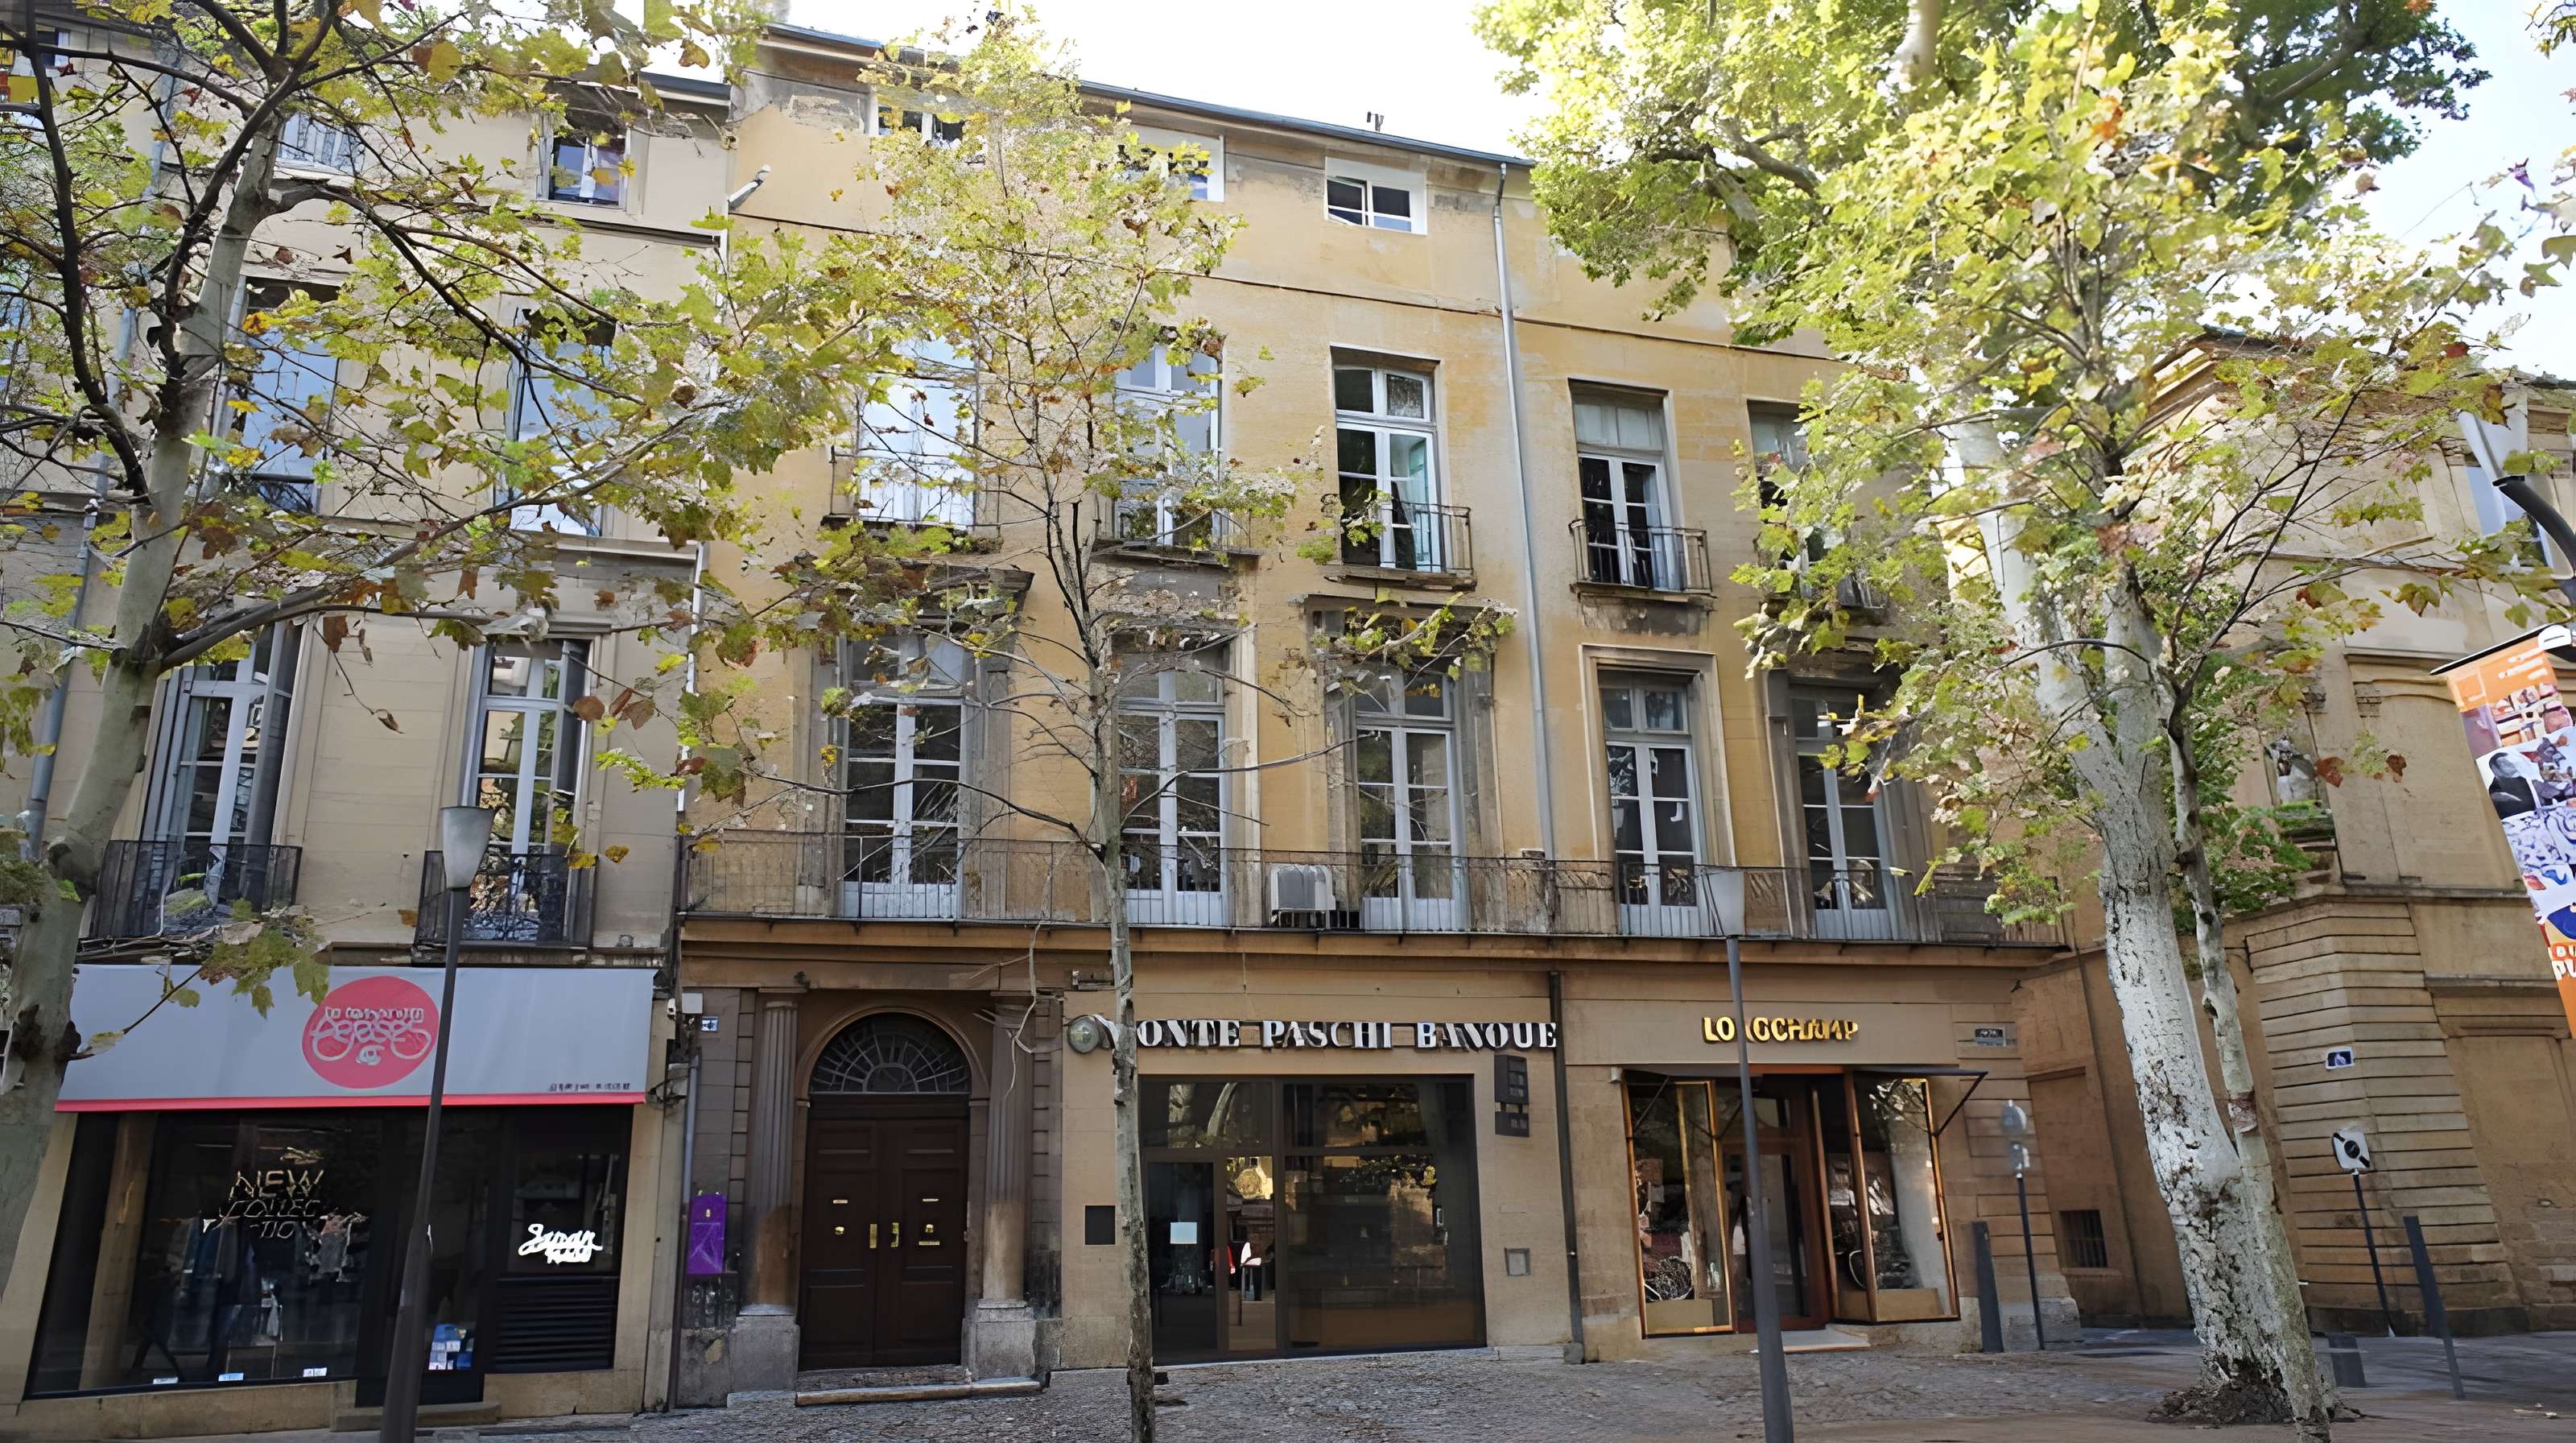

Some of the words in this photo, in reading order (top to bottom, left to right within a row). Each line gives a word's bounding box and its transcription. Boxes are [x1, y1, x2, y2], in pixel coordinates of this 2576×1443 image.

[1261, 1020, 1392, 1048] PASCHI
[1702, 1016, 1859, 1042] LOGCHAMP
[229, 1169, 324, 1199] NEW
